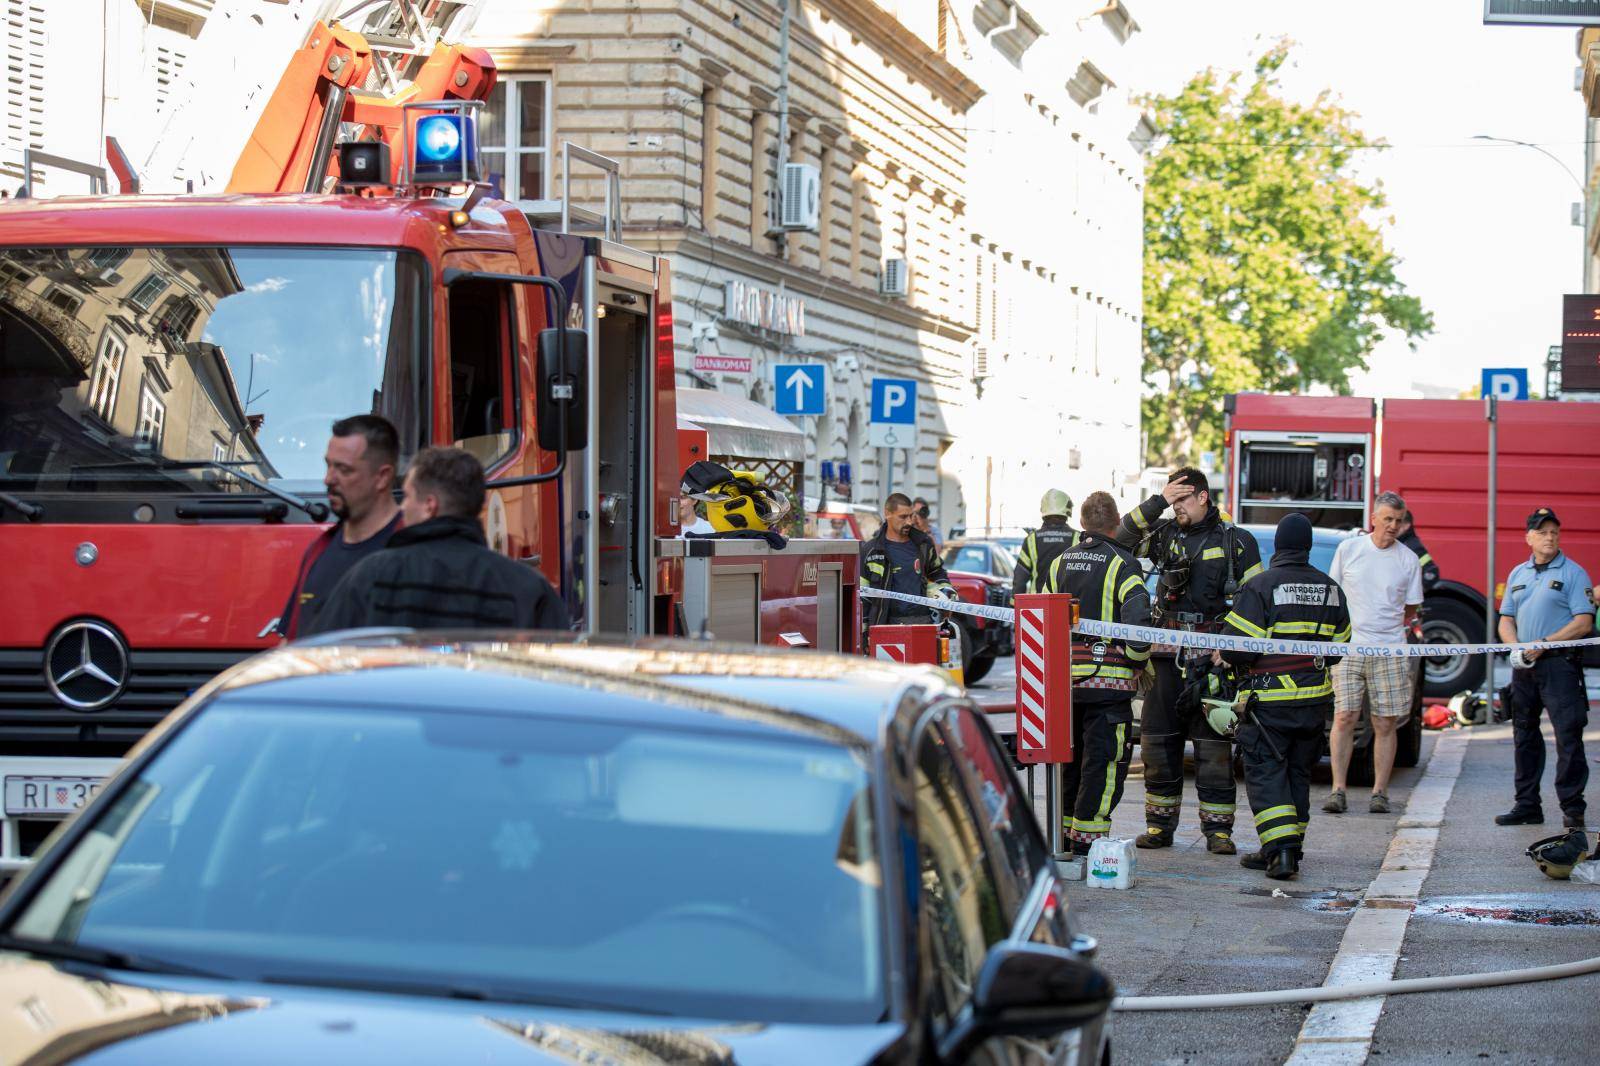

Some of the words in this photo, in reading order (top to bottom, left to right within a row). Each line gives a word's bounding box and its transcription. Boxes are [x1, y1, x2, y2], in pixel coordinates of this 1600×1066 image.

[696, 358, 750, 371] BANKOMAT
[1492, 374, 1518, 401] P
[883, 385, 906, 417] P
[1062, 552, 1107, 563] VATROGASCI
[1066, 563, 1091, 571] RIJEKA
[1295, 594, 1321, 602] RIJEKA
[24, 783, 48, 807] RI
